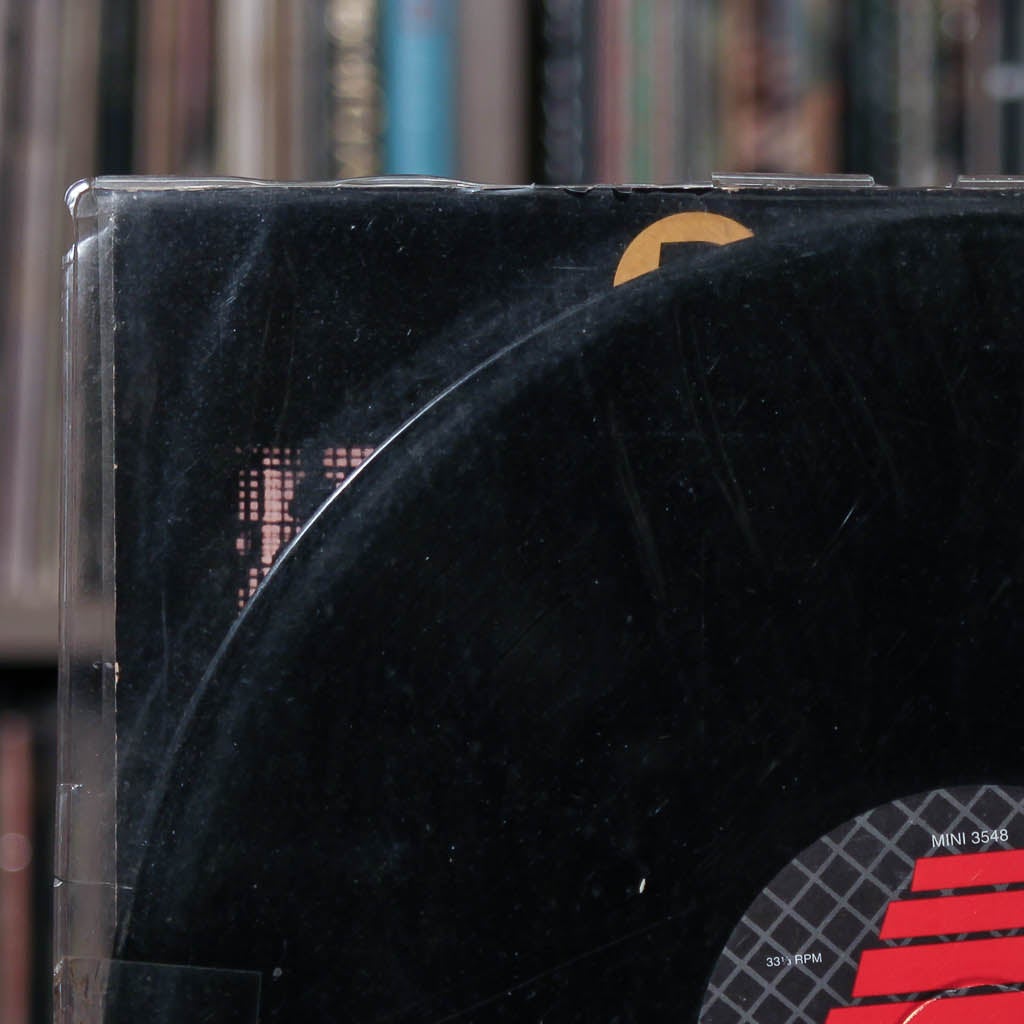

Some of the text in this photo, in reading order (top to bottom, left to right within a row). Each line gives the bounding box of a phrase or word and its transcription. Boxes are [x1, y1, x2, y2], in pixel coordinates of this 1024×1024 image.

[931, 828, 1009, 848] MINI 3548
[794, 952, 823, 965] RPM
